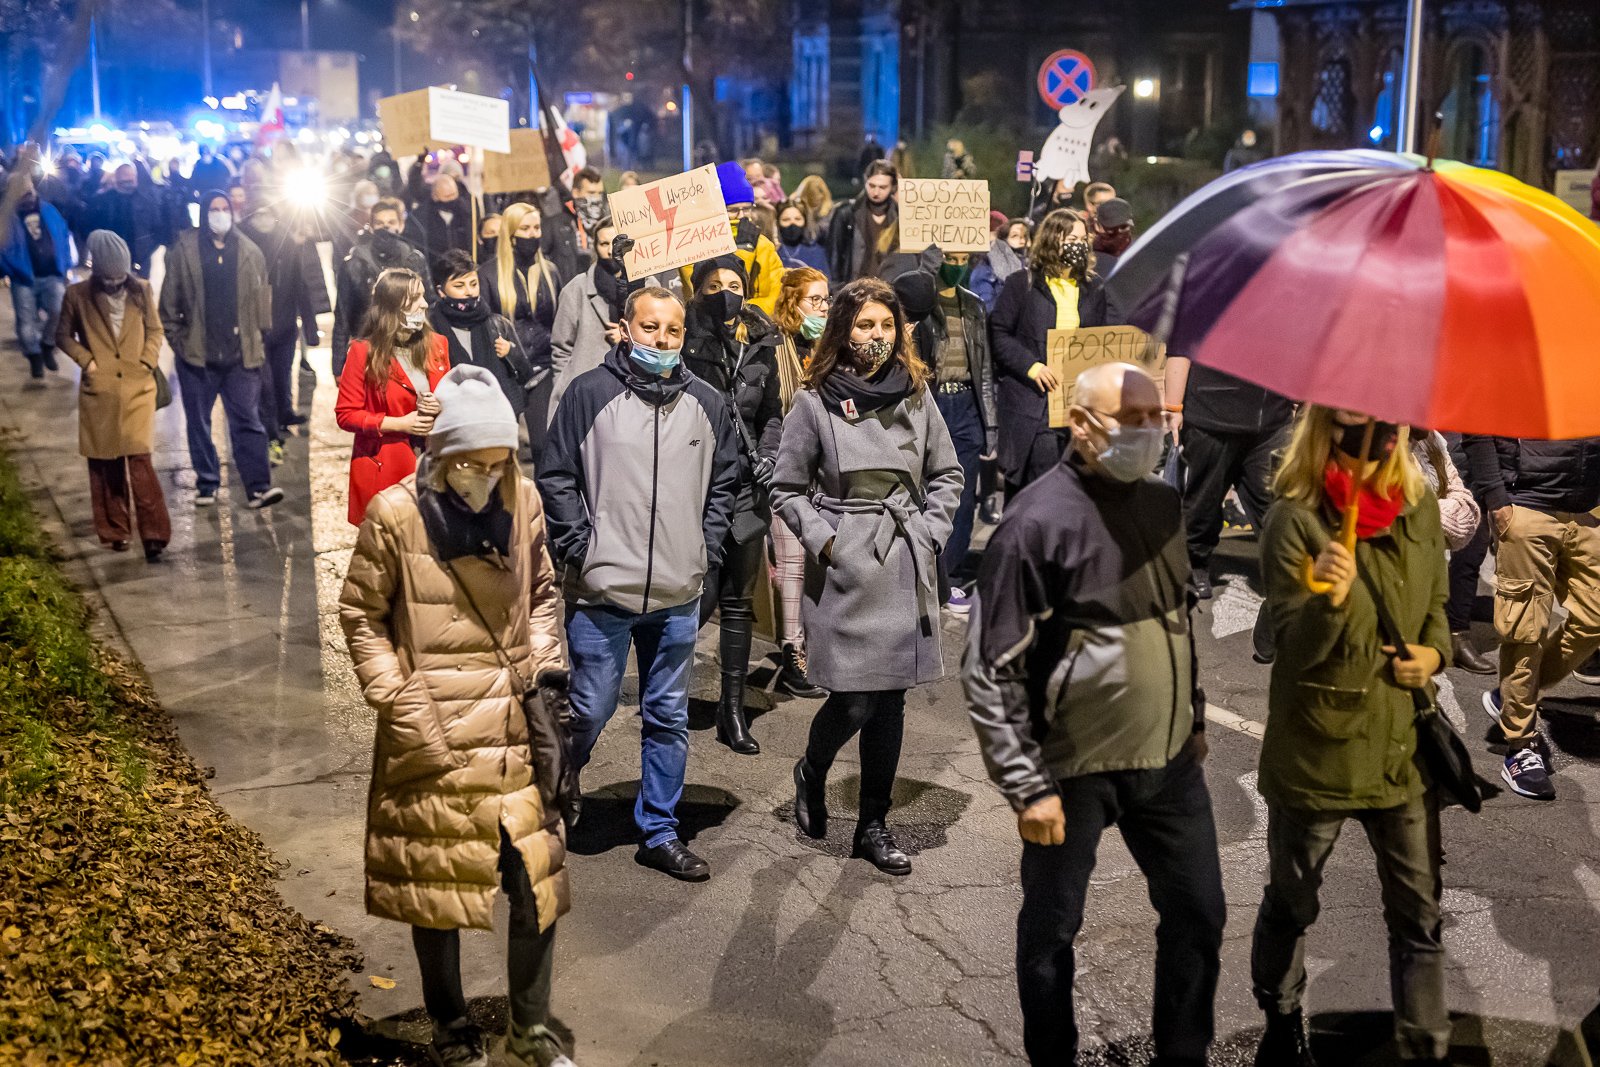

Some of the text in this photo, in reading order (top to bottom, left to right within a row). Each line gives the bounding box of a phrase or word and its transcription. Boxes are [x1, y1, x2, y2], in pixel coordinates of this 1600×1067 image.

[617, 178, 704, 229] WOLNY WYBÓR
[904, 180, 984, 204] BOSAK
[905, 204, 989, 220] JEST GORSZY
[633, 238, 662, 265] NIE
[676, 222, 728, 250] ZAKAZ
[921, 223, 987, 246] FRIENDS
